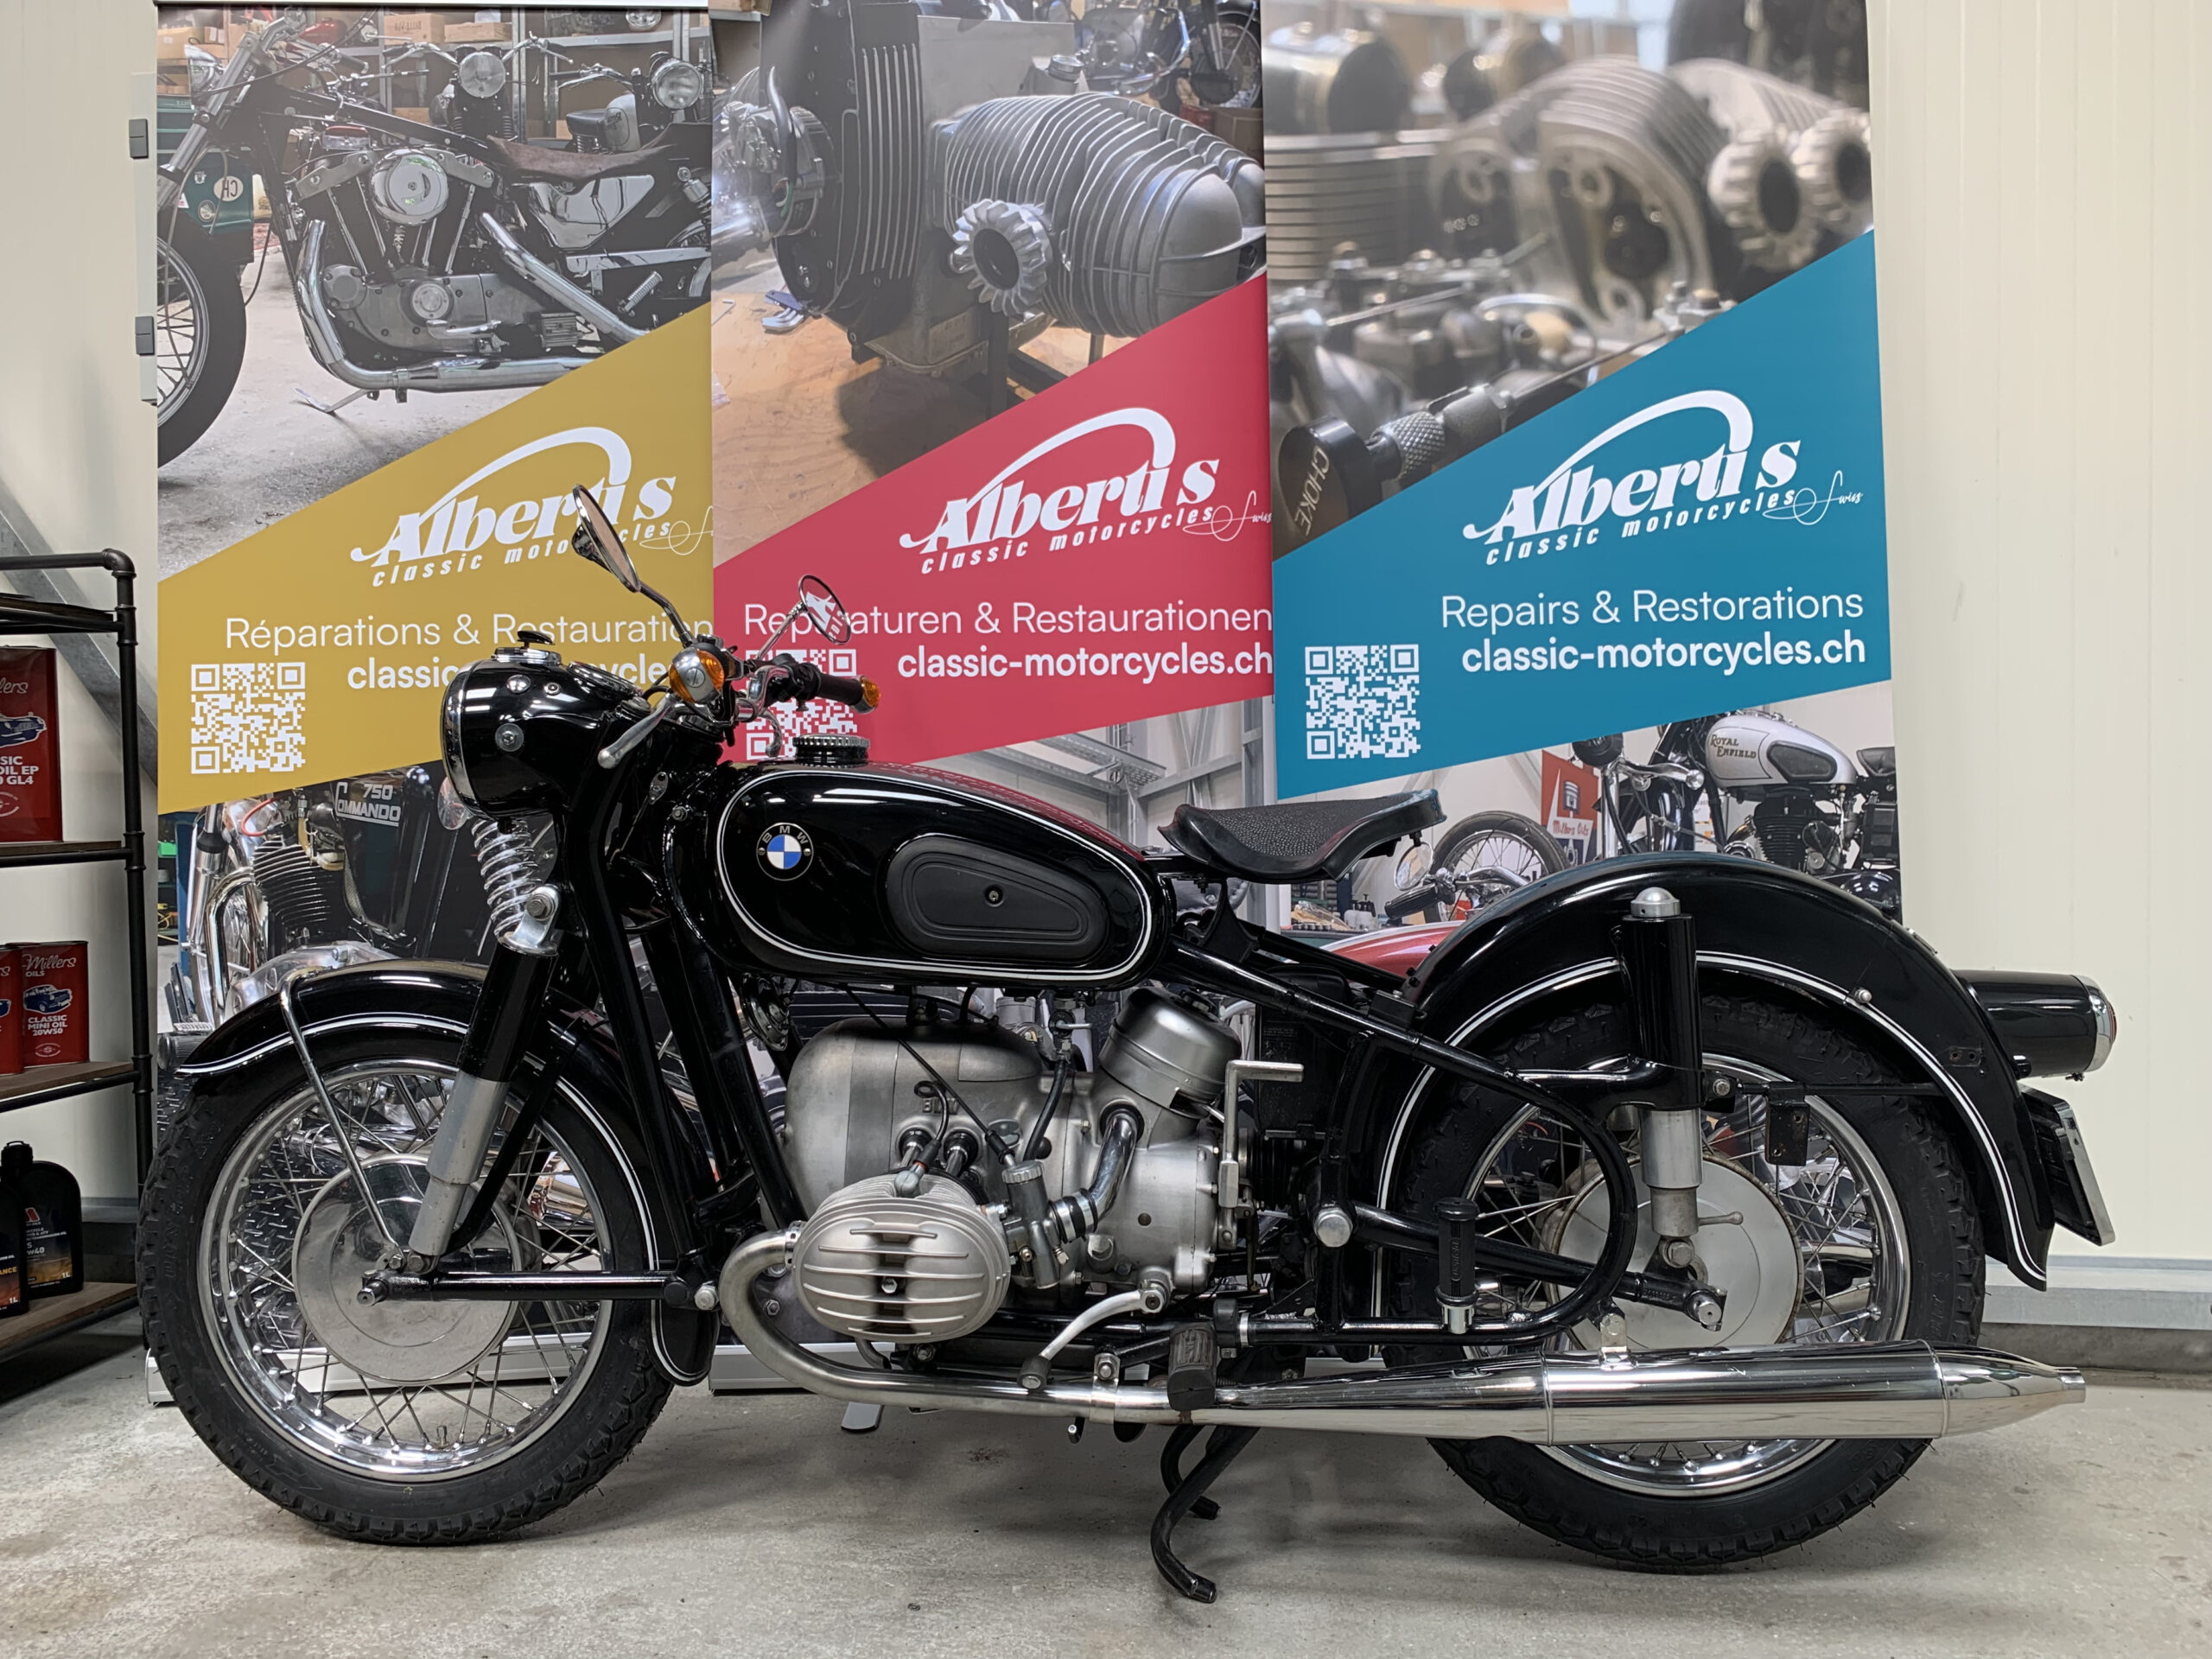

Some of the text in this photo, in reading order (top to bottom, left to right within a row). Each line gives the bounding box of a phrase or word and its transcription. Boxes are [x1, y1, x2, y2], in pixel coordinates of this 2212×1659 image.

[1294, 446, 1329, 536] CHOKE
[921, 540, 1028, 575] classic
[1049, 506, 1214, 551] motorcycles
[1486, 526, 1599, 565] classic
[1621, 488, 1796, 538] motorcycles
[372, 552, 482, 588] classic
[505, 521, 671, 564] motocles
[745, 602, 962, 643] Repaturen
[974, 601, 1001, 633] &
[1013, 600, 1272, 633] Restaurationen
[1442, 587, 1864, 635] Repairs & Restorations
[226, 615, 441, 656] Réparations
[453, 613, 480, 645] &
[1462, 629, 1866, 676] classic-motorcycles.ch
[898, 642, 1273, 683] classic-motorcycles.ch
[1711, 734, 1739, 747] ROYAL
[1716, 746, 1757, 759] ENFIELD
[6, 775, 34, 785] GL4
[22, 766, 39, 775] EP
[334, 782, 401, 827] COMMANDO
[363, 783, 393, 800] 750
[761, 825, 809, 844] BMW
[22, 954, 77, 970] Millers
[28, 1014, 67, 1024] CLASSIC
[32, 1027, 63, 1036] 20W50
